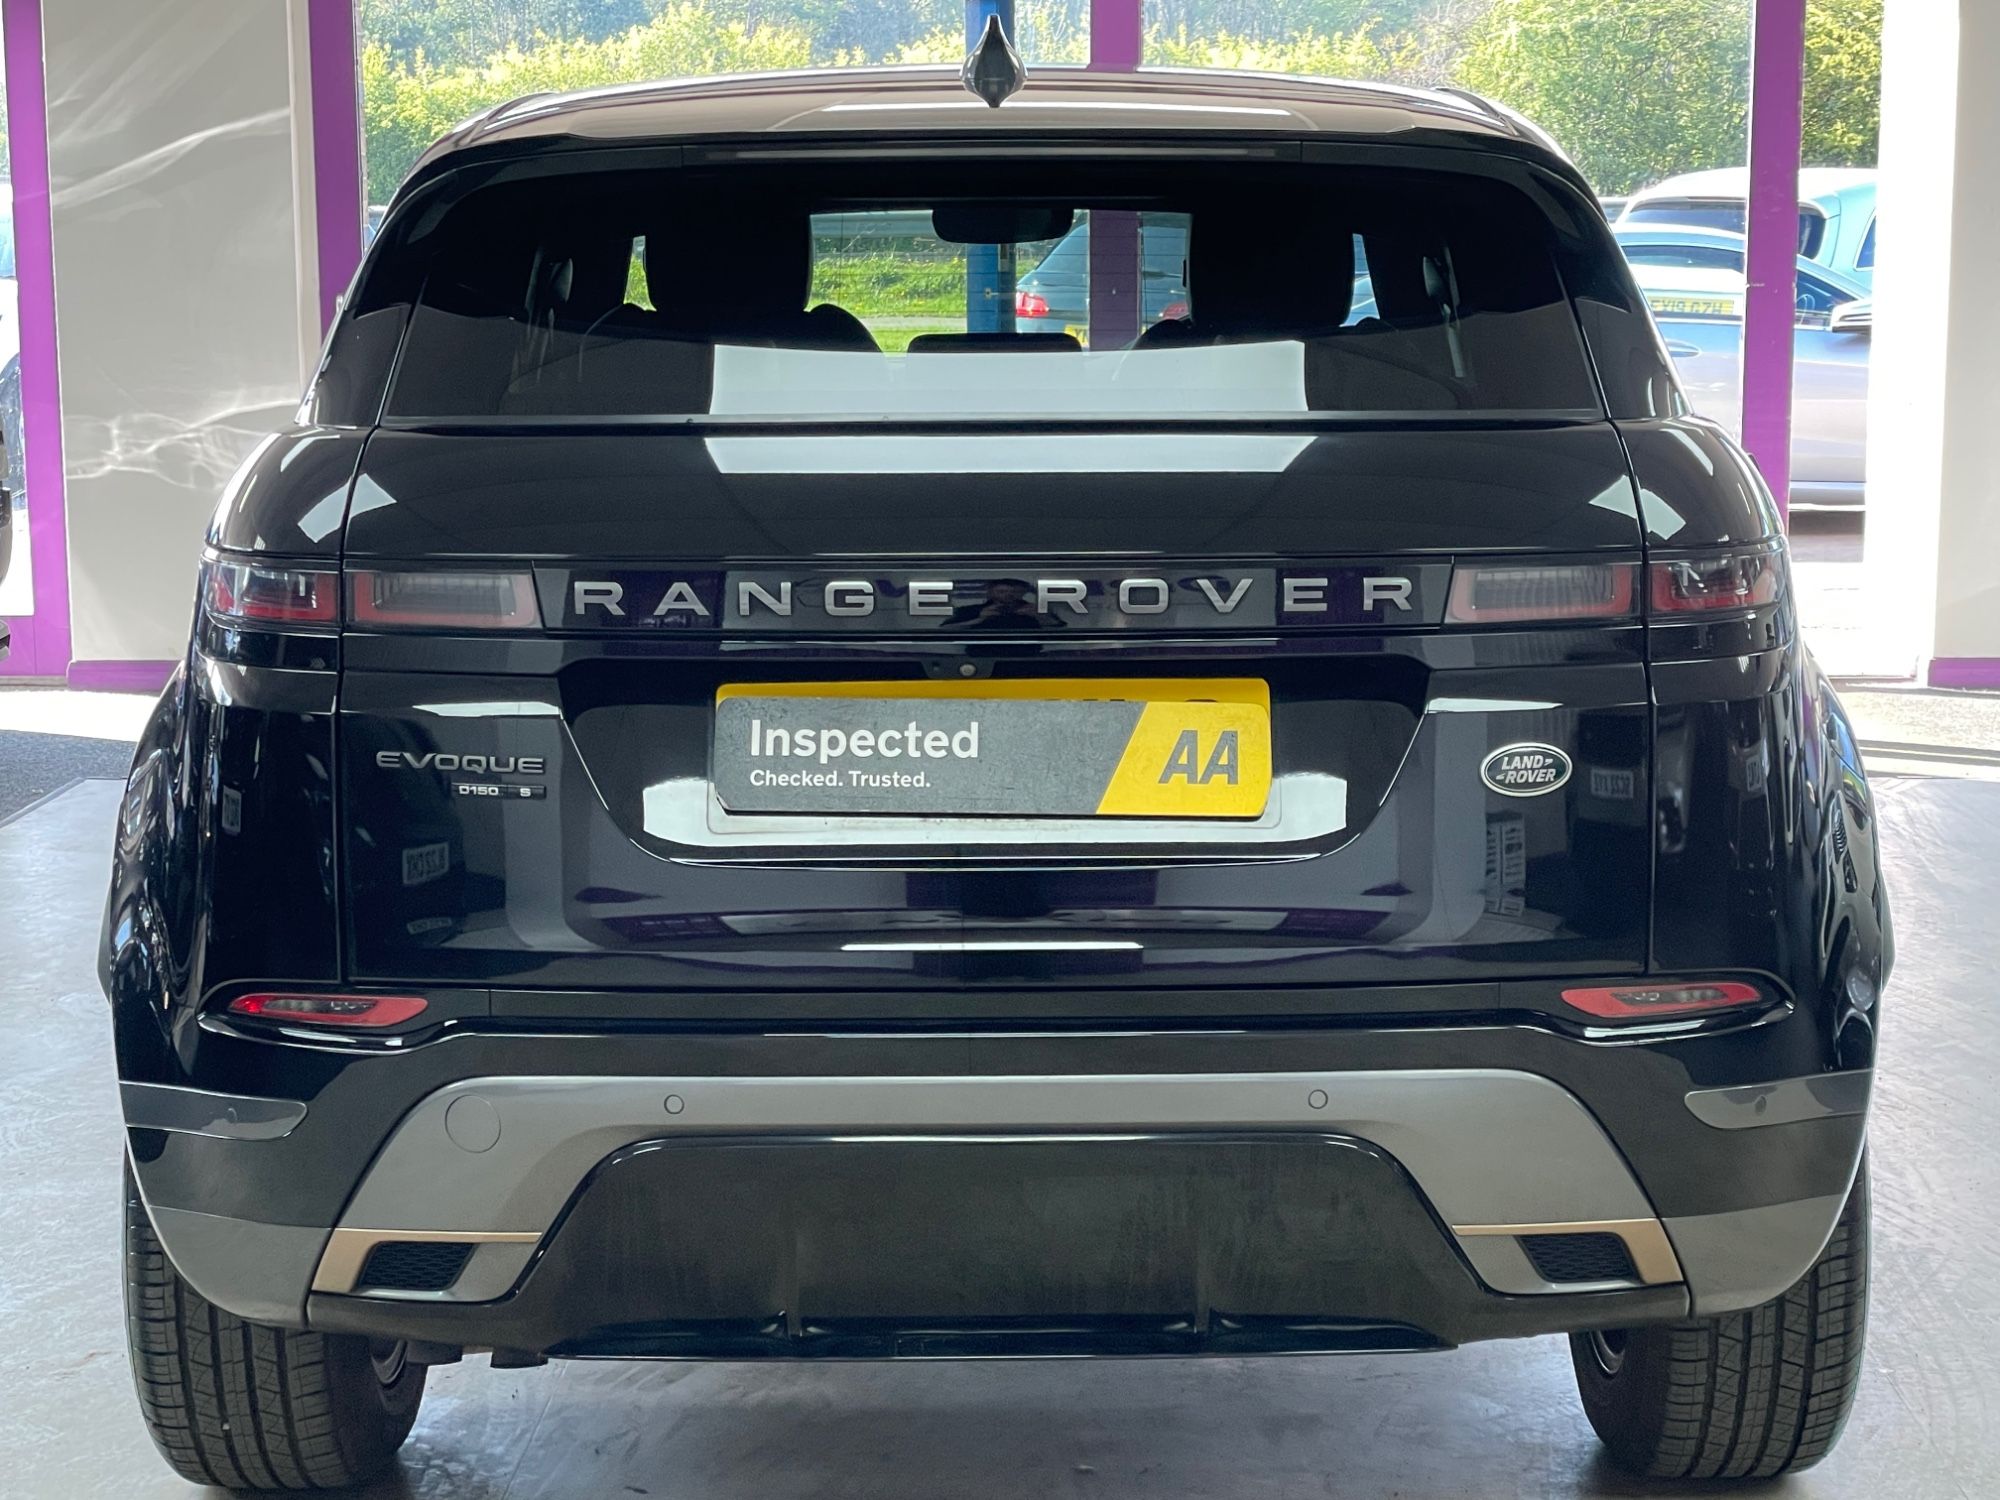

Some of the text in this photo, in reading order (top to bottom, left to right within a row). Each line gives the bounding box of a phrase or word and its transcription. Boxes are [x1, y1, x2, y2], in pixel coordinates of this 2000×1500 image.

[573, 577, 1413, 617] RANGE ROVER
[751, 719, 979, 764] Inspected
[375, 751, 545, 775] EVOQUE
[1158, 729, 1239, 785] AA
[1502, 755, 1543, 770] LAND
[750, 769, 931, 788] Checked. Trusted.
[1505, 769, 1556, 783] ROVER
[459, 785, 532, 798] D150 S
